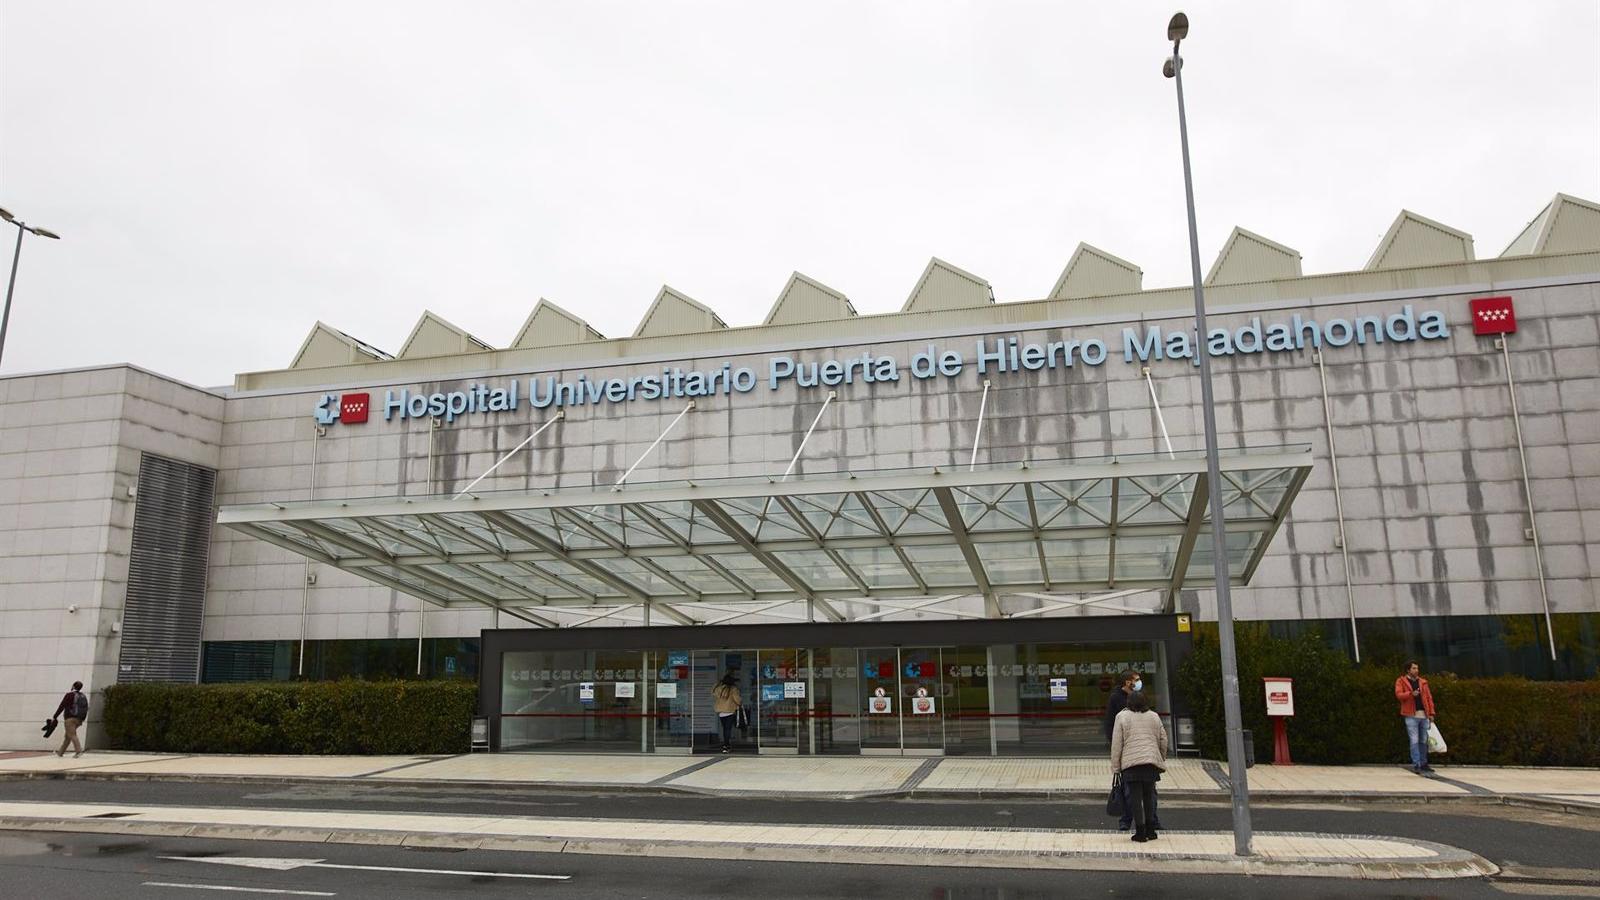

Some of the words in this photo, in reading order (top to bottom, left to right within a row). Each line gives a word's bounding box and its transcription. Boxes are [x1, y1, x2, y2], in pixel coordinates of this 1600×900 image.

[383, 379, 519, 422] Hospital
[530, 363, 756, 409] Universitario
[770, 353, 899, 389] Puerta
[911, 344, 964, 379] de
[976, 337, 1108, 374] Hierro
